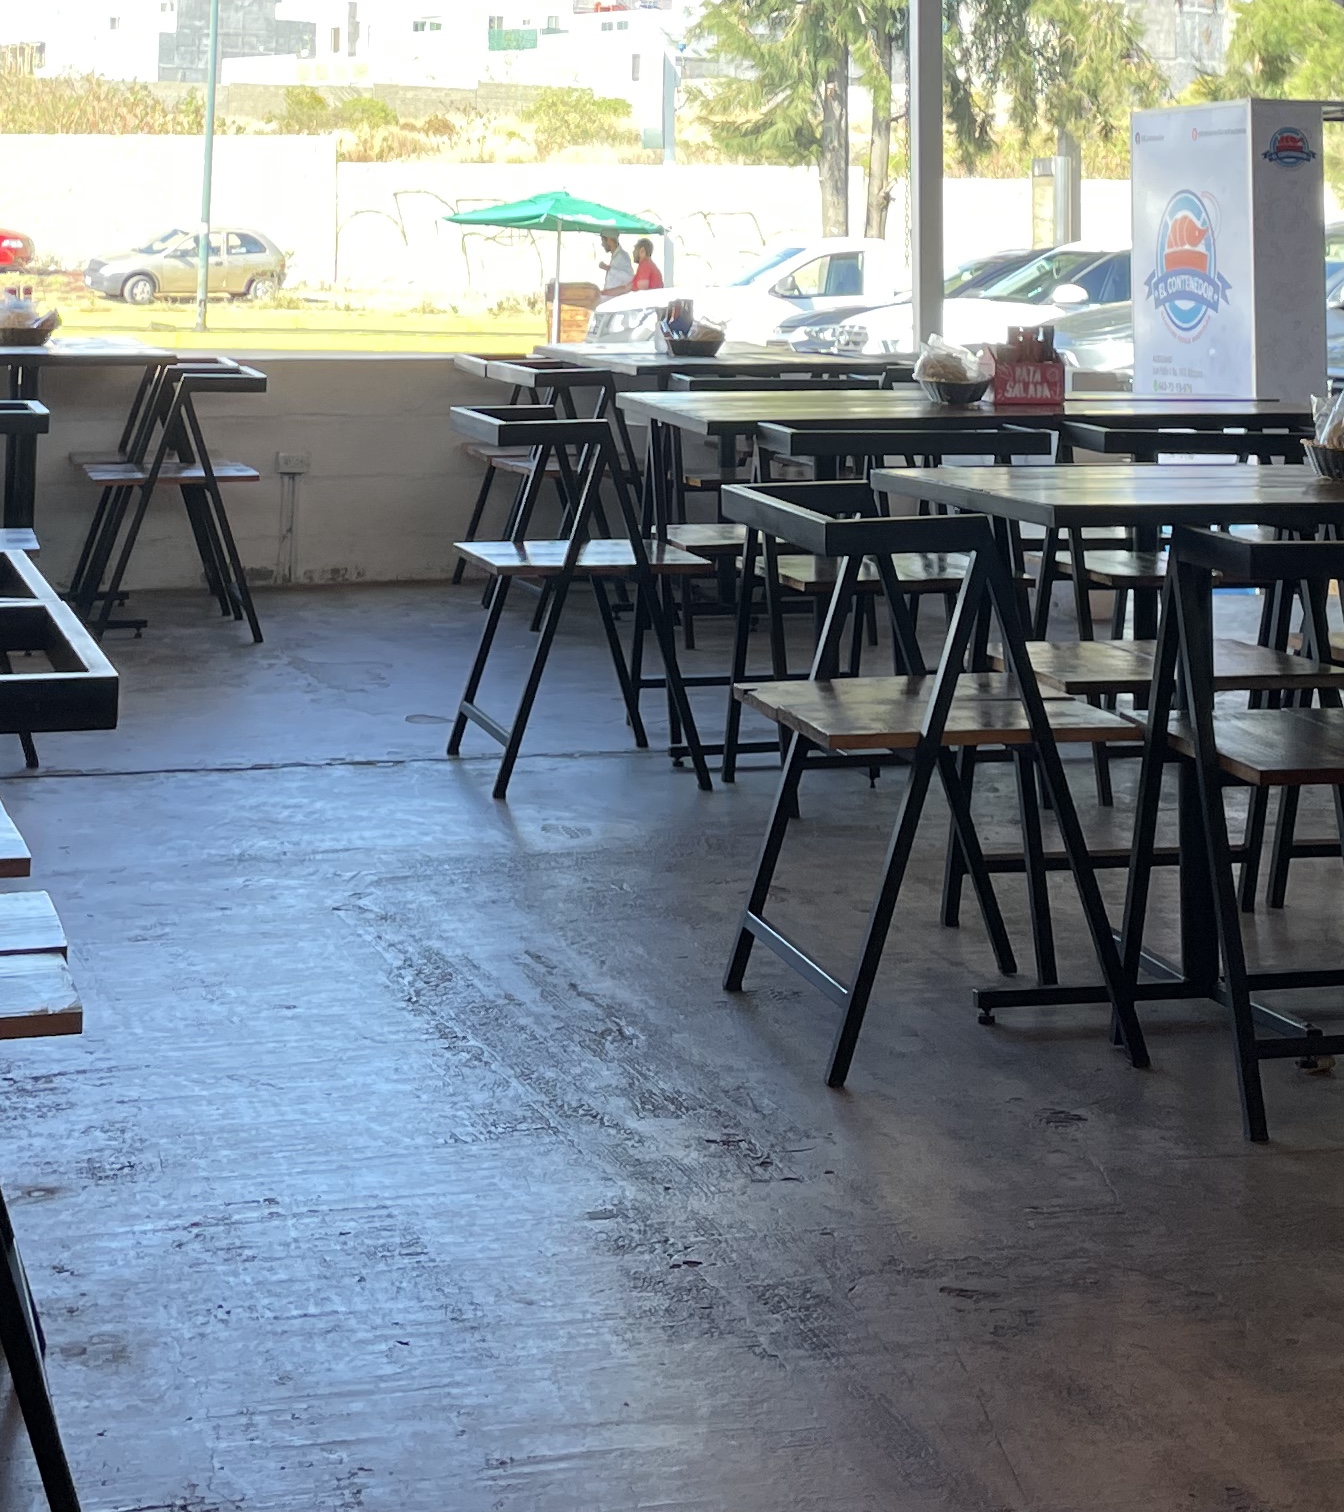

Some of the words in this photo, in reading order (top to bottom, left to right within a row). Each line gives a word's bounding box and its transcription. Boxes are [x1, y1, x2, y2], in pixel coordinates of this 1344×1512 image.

[1158, 282, 1167, 299] EL
[1167, 274, 1214, 303] CONTENEDOR
[1004, 381, 1052, 399] SALADA
